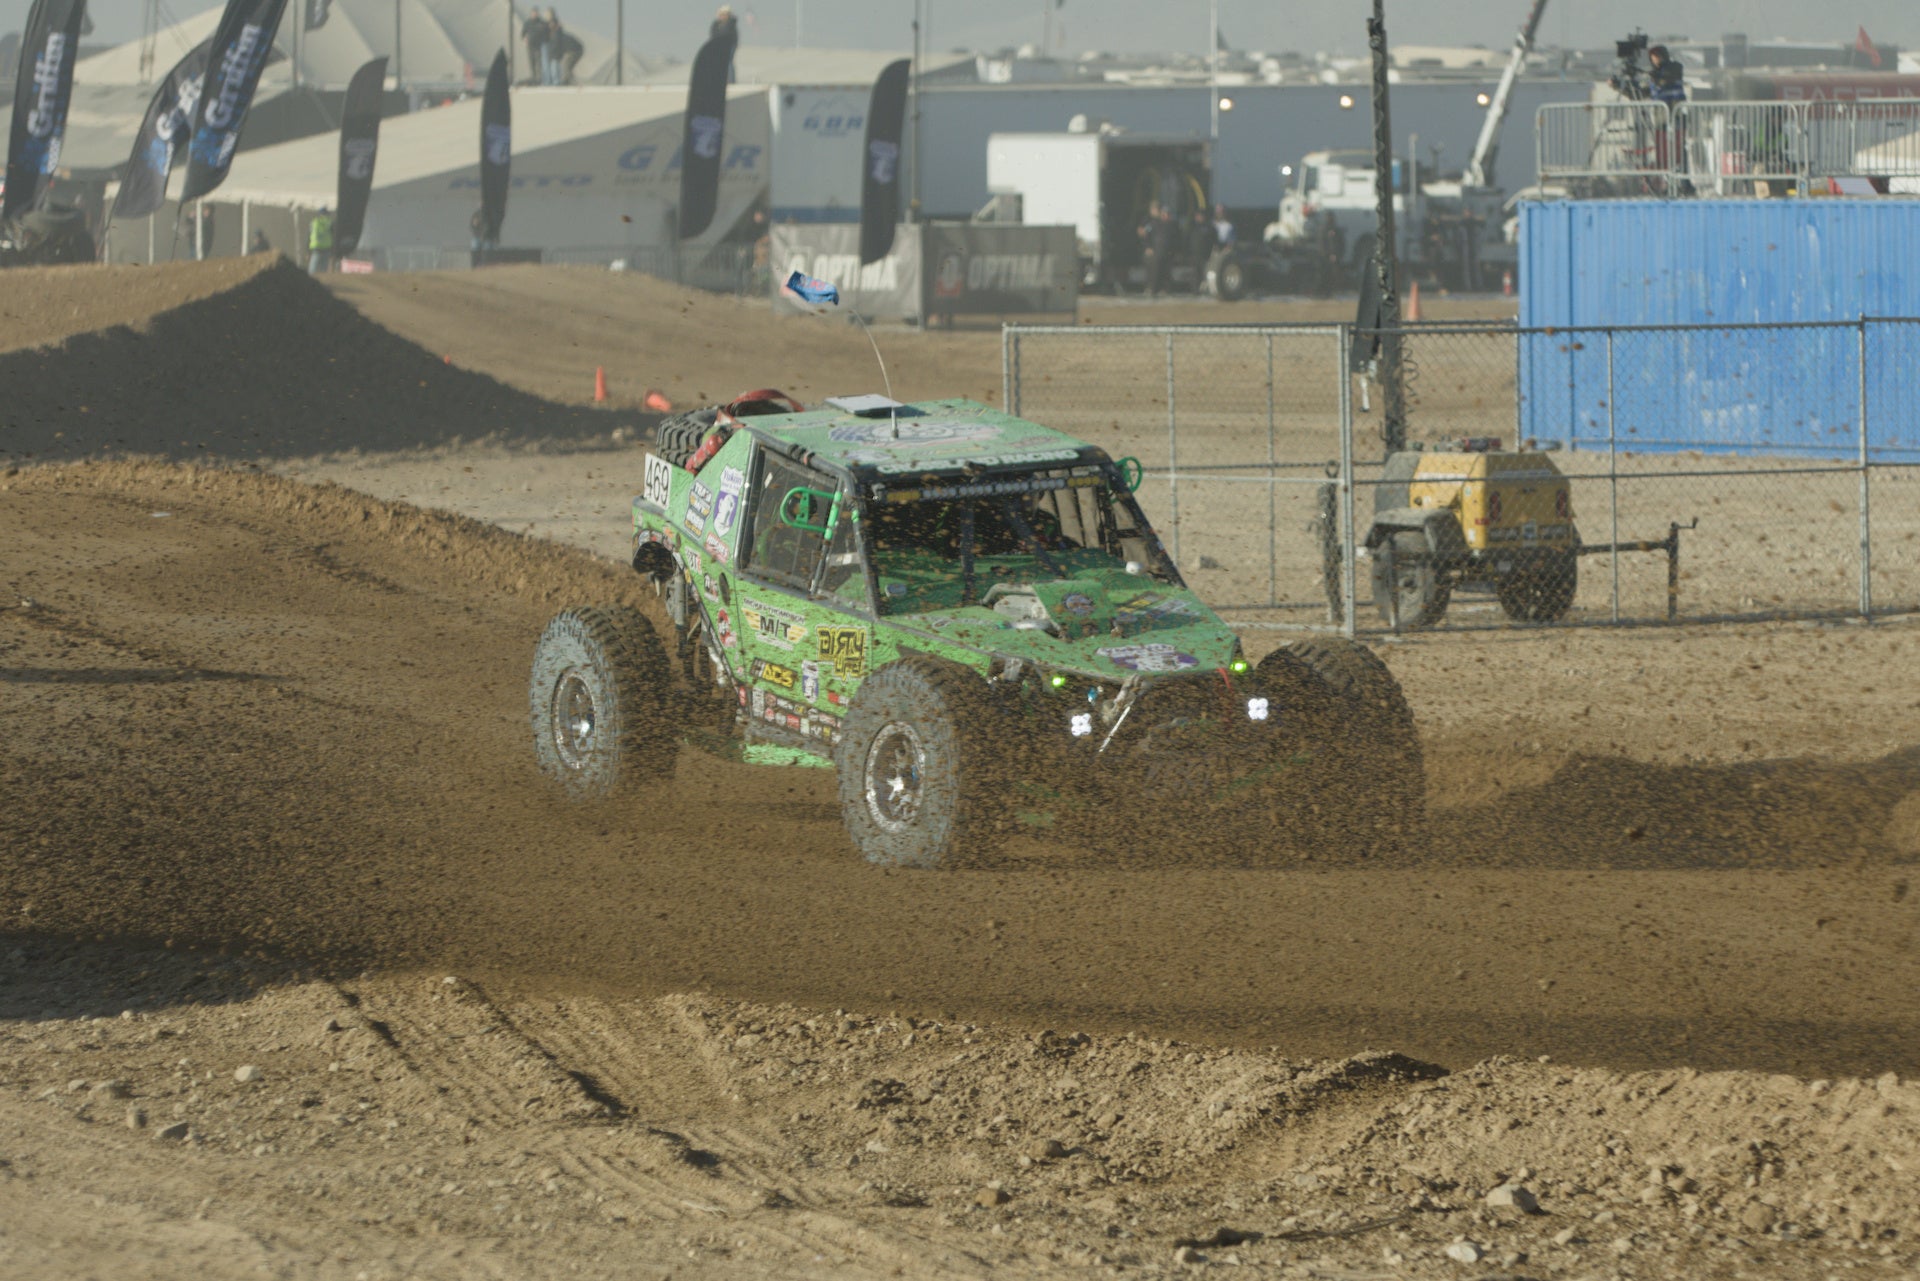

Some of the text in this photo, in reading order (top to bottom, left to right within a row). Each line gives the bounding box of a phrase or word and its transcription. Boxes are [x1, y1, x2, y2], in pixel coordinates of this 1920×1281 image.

[617, 144, 762, 172] GR
[966, 253, 1056, 290] OPTIMA
[645, 458, 670, 507] 469
[760, 615, 791, 638] M/T
[818, 629, 865, 656] DIRTY
